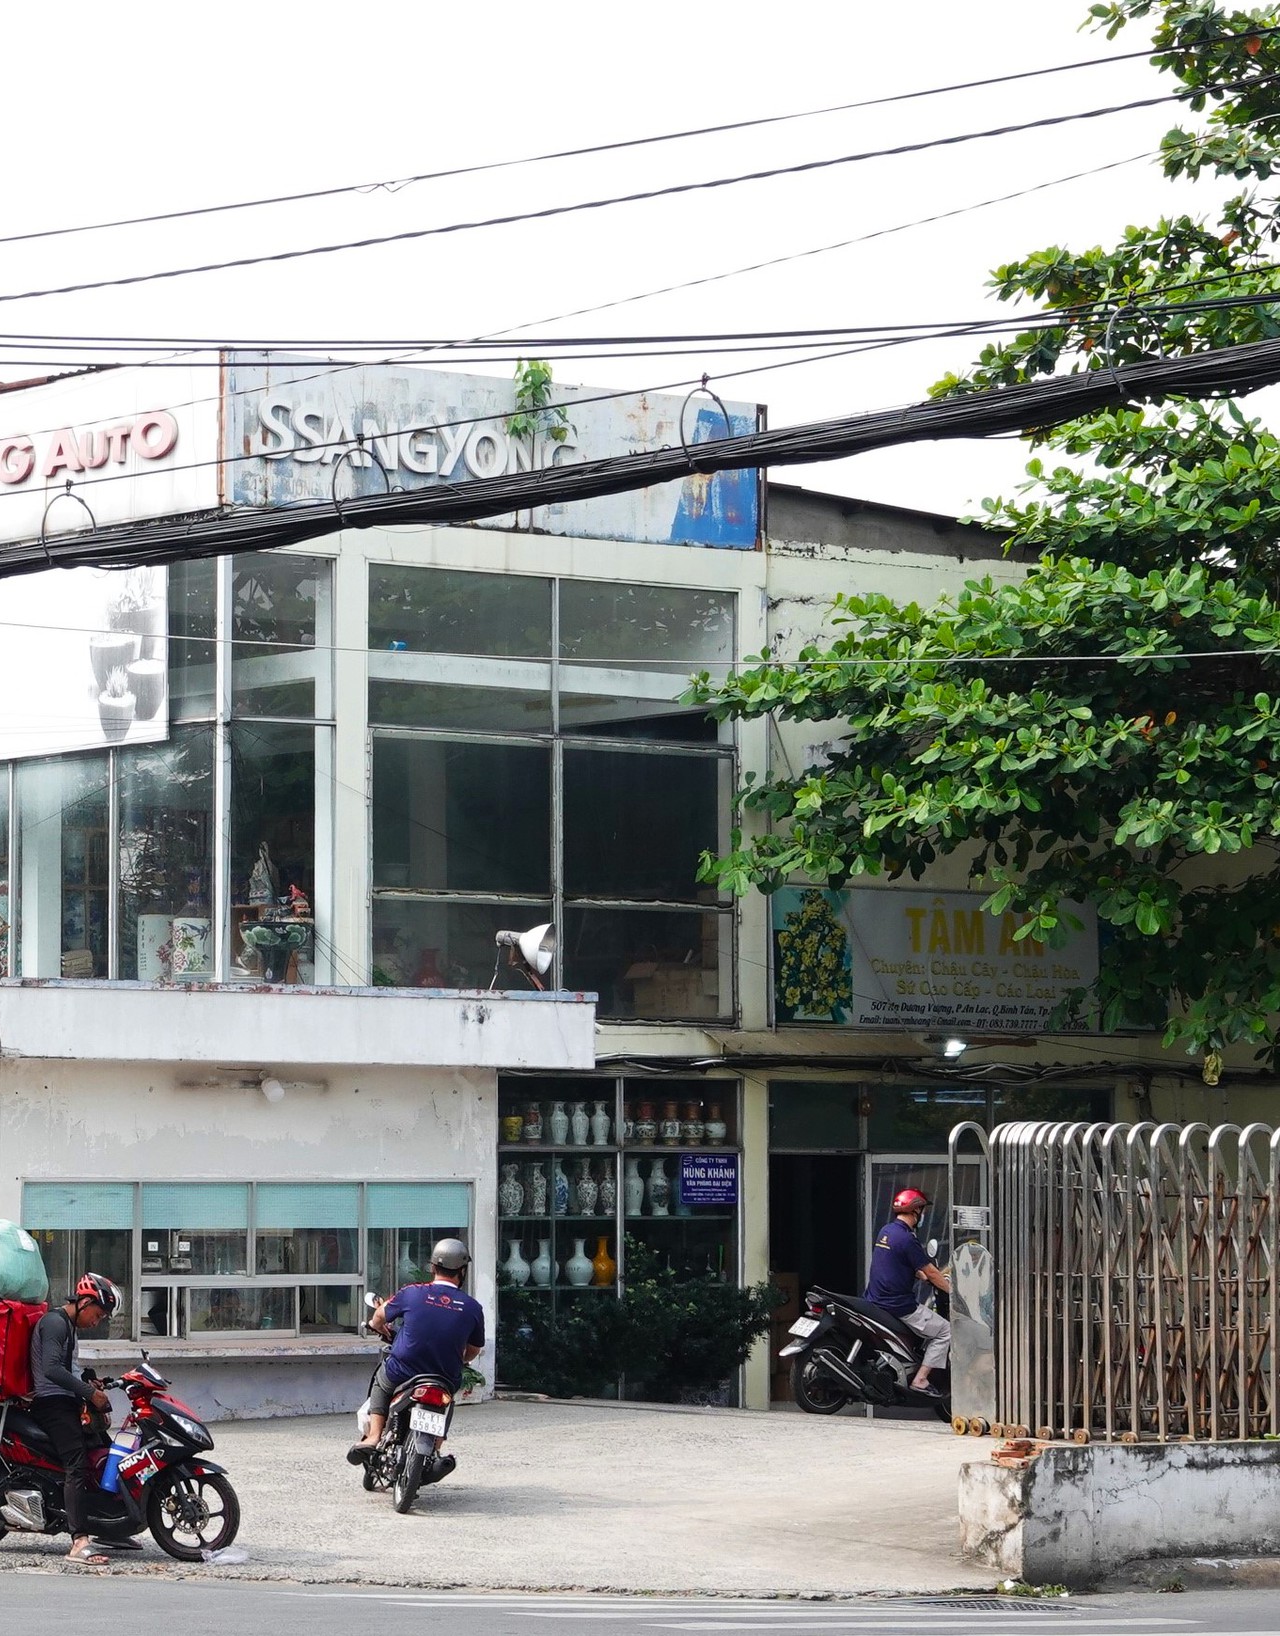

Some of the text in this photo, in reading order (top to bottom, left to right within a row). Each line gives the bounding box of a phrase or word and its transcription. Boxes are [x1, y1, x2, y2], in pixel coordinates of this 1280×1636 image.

[905, 897, 985, 955] TÂM
[683, 1165, 735, 1178] HÙNG KHÁNH
